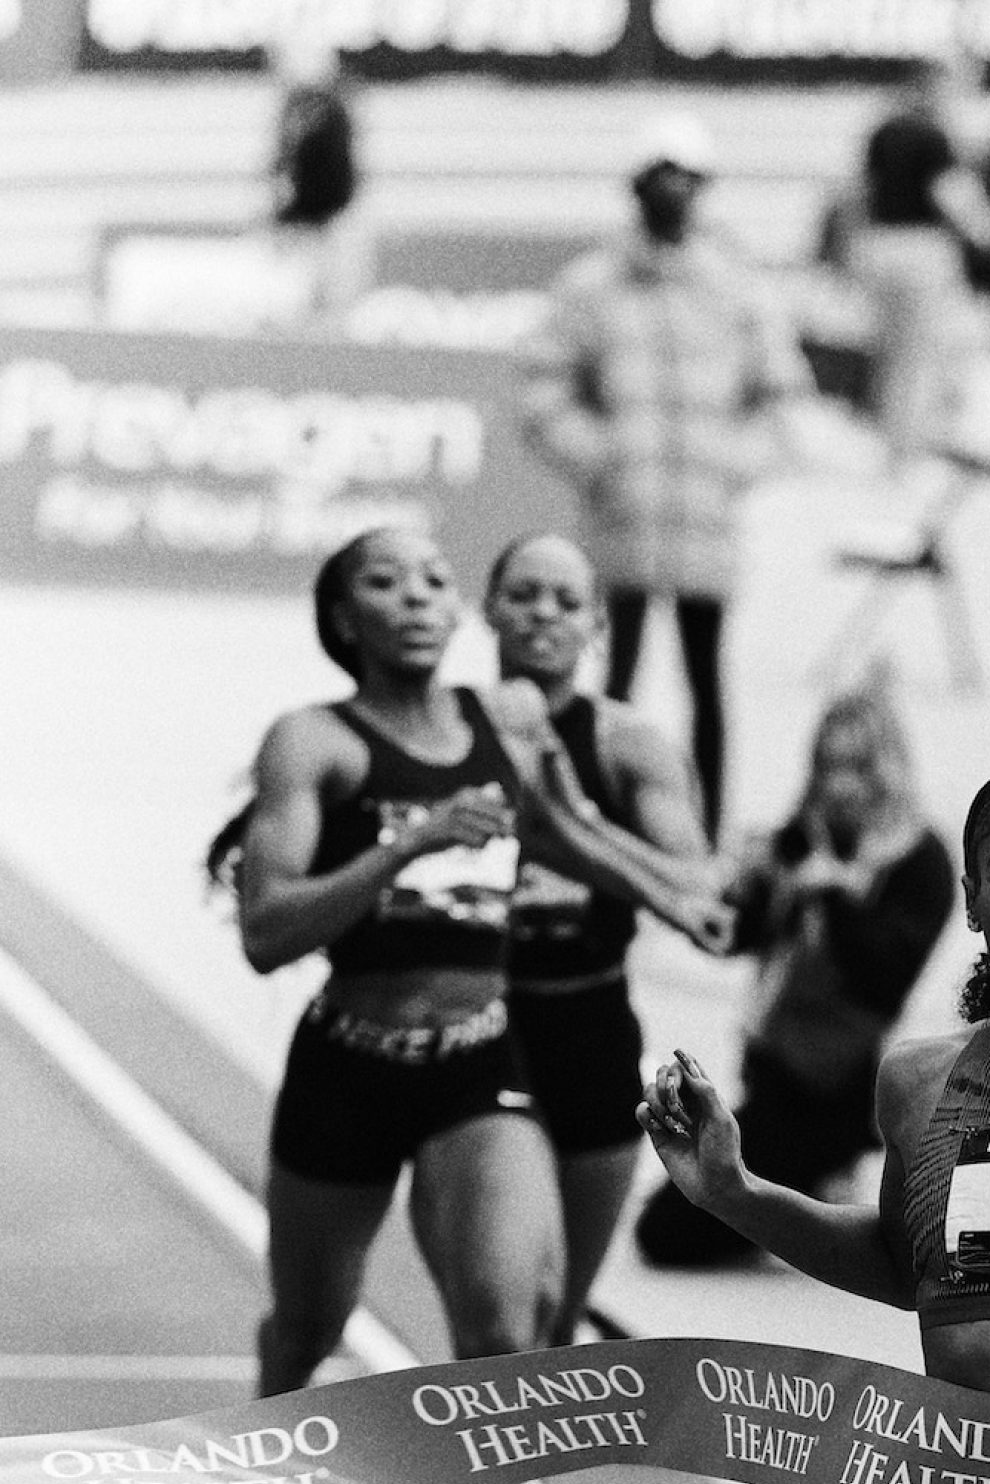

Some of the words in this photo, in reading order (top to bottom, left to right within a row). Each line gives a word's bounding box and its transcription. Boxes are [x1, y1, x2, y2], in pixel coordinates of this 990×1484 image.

[413, 1364, 645, 1426] ORLANDO
[696, 1358, 835, 1422] ORLANDO
[42, 1415, 339, 1478] ORLANDO
